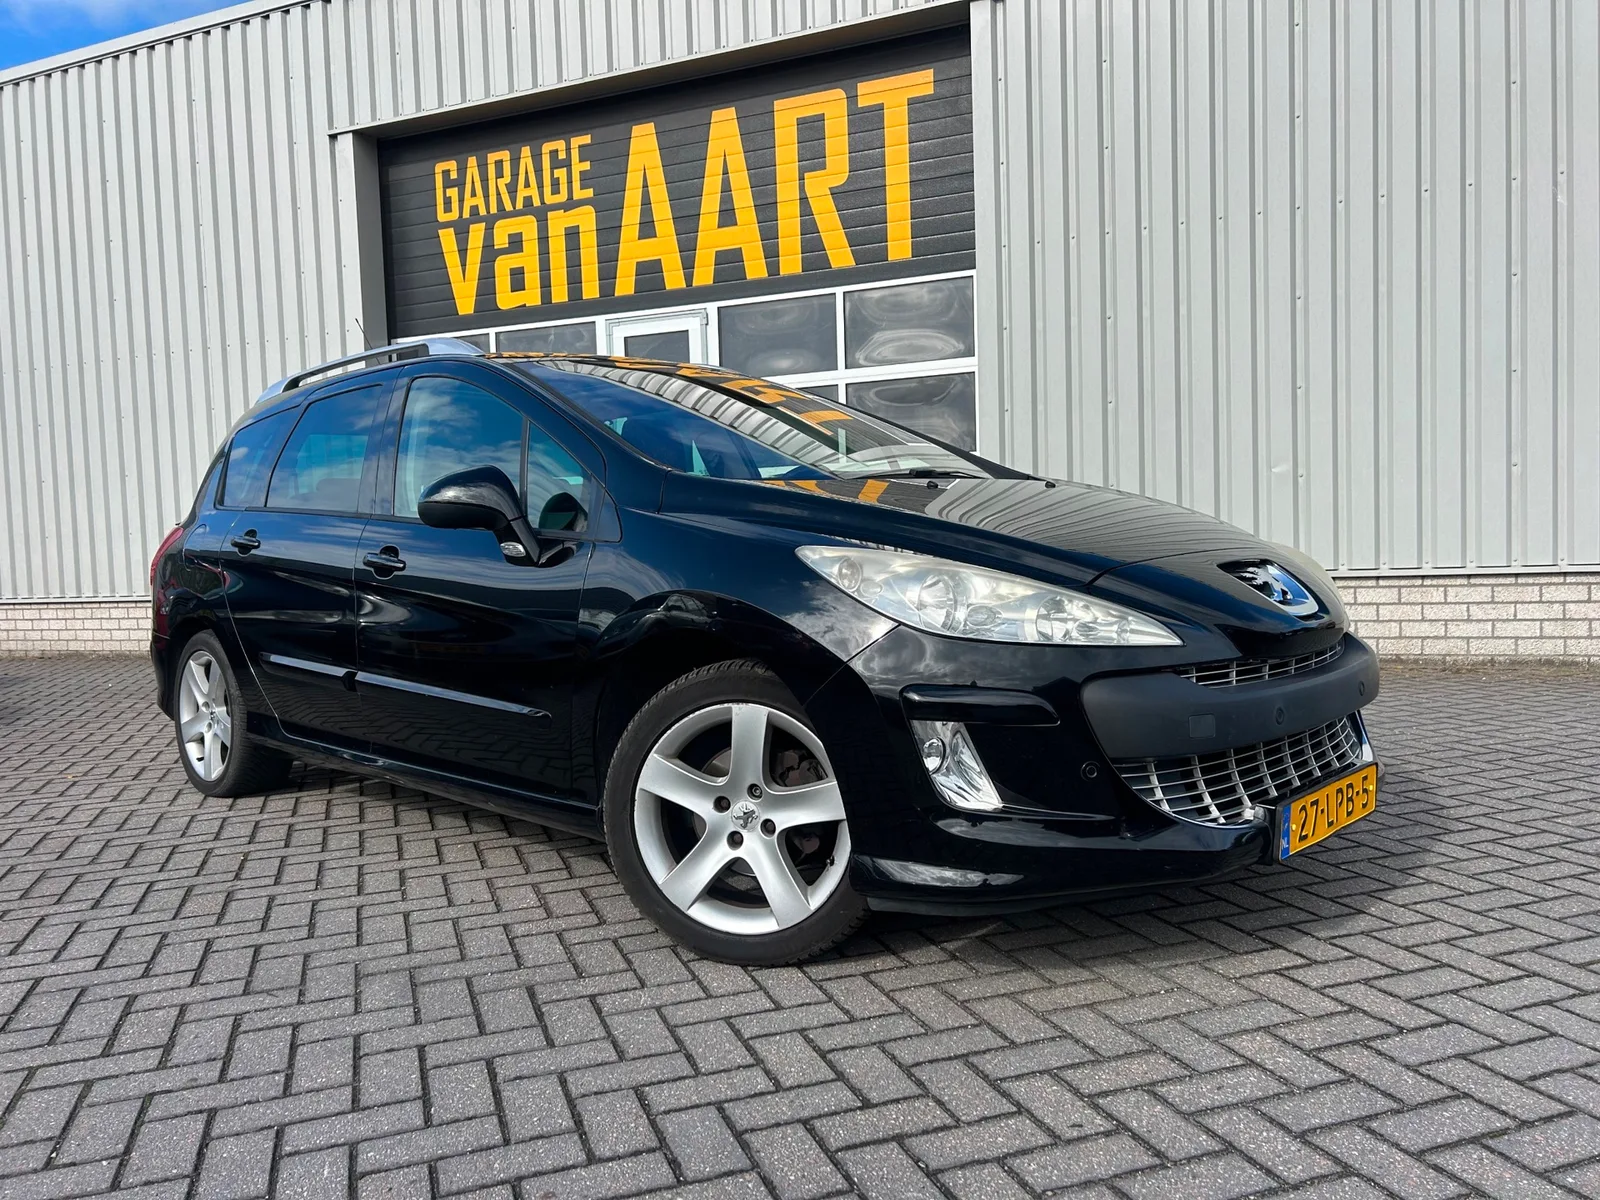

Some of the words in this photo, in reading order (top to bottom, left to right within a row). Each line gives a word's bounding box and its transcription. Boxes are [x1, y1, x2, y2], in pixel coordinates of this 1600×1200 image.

[434, 134, 594, 223] GARAGE
[438, 204, 600, 315] van
[614, 68, 934, 297] AART
[1298, 774, 1369, 843] 27-LPB-5
